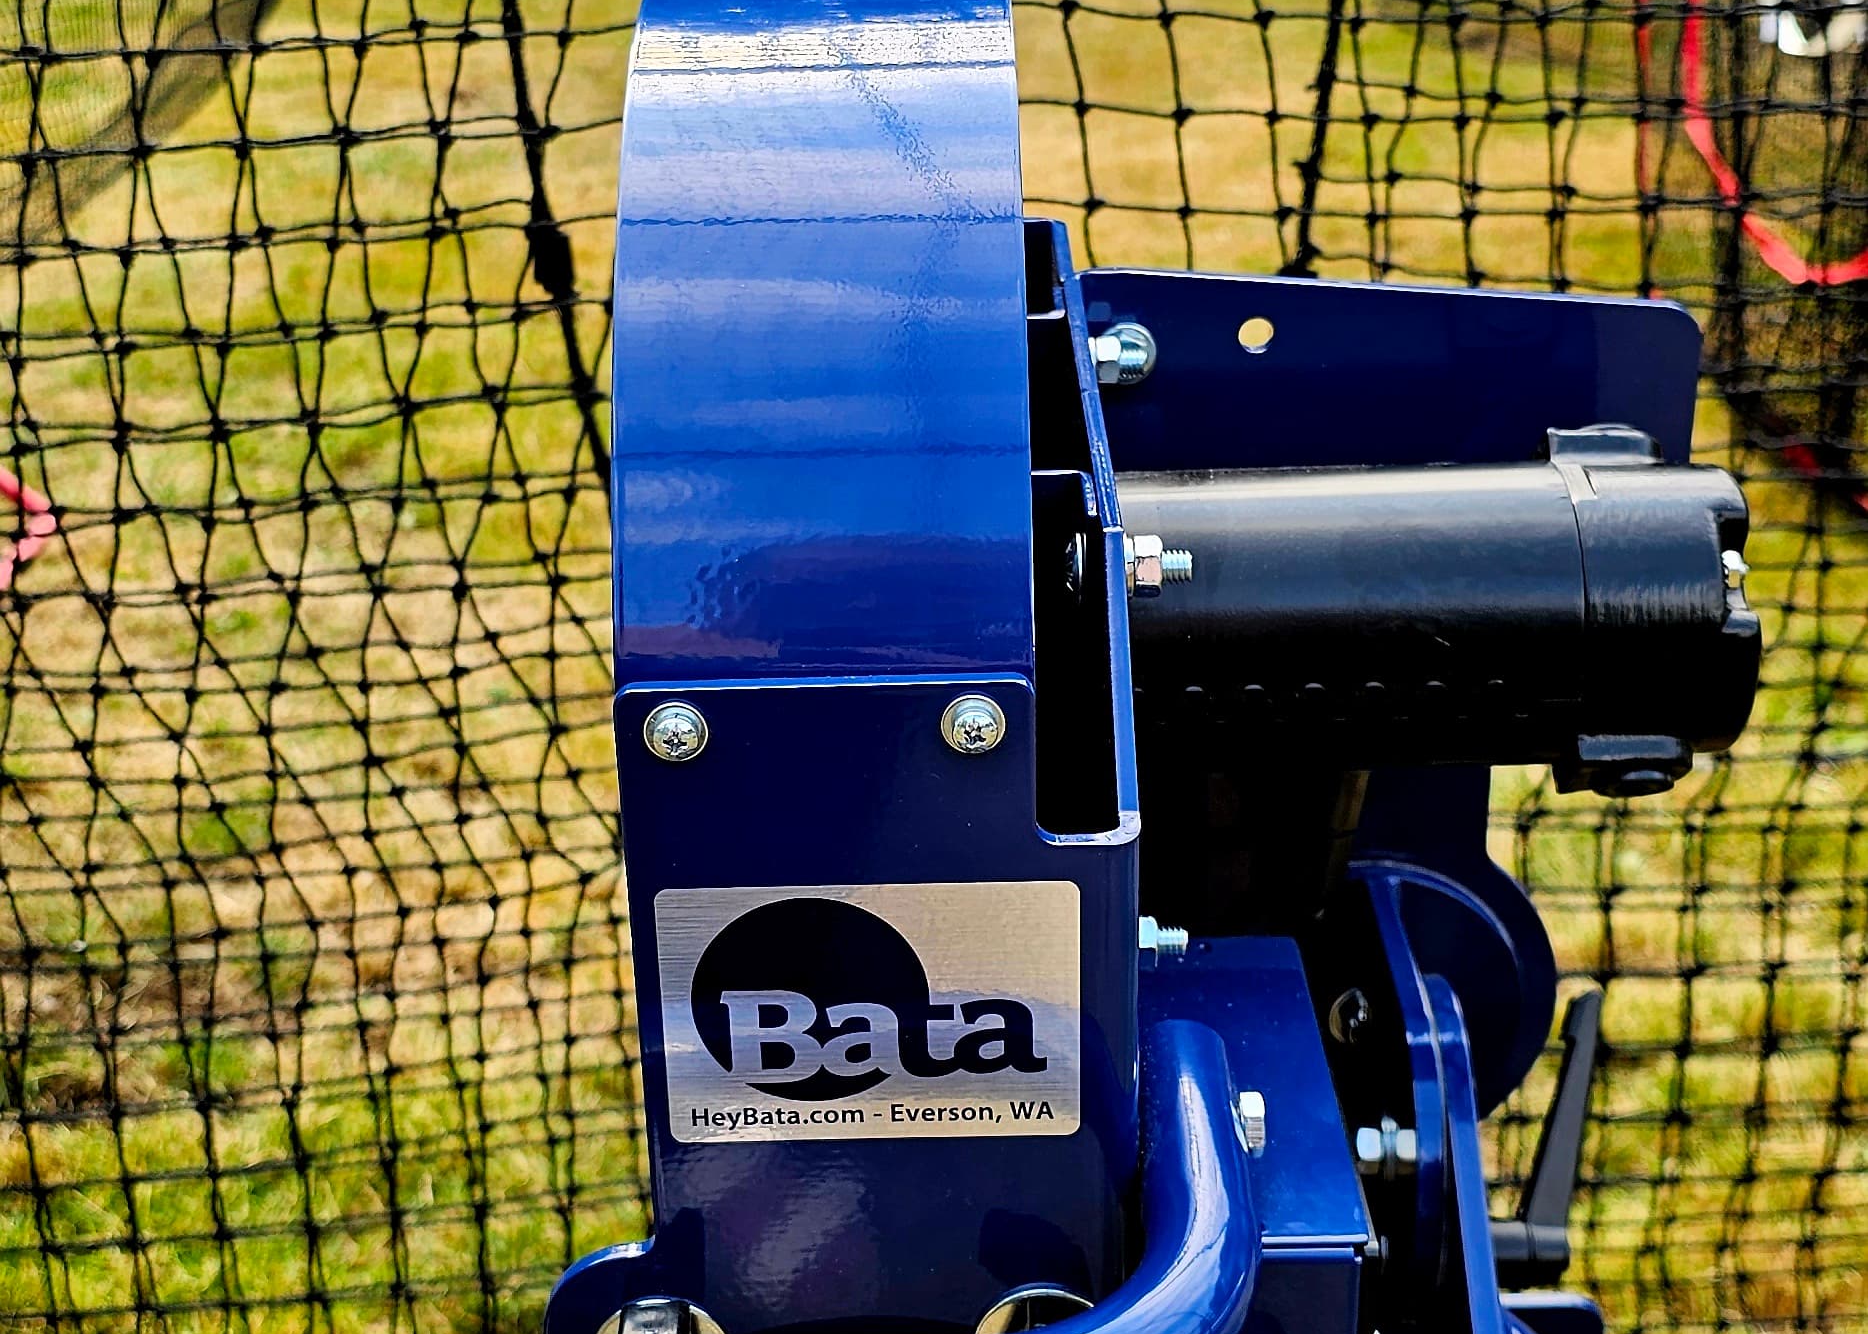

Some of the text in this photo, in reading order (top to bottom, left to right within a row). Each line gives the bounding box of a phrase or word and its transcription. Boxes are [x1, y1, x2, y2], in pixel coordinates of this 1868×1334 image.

[720, 990, 1047, 1084] Bata
[691, 1107, 864, 1131] HeyBata.com
[891, 1103, 1001, 1124] Everson,
[1010, 1101, 1054, 1120] WA
